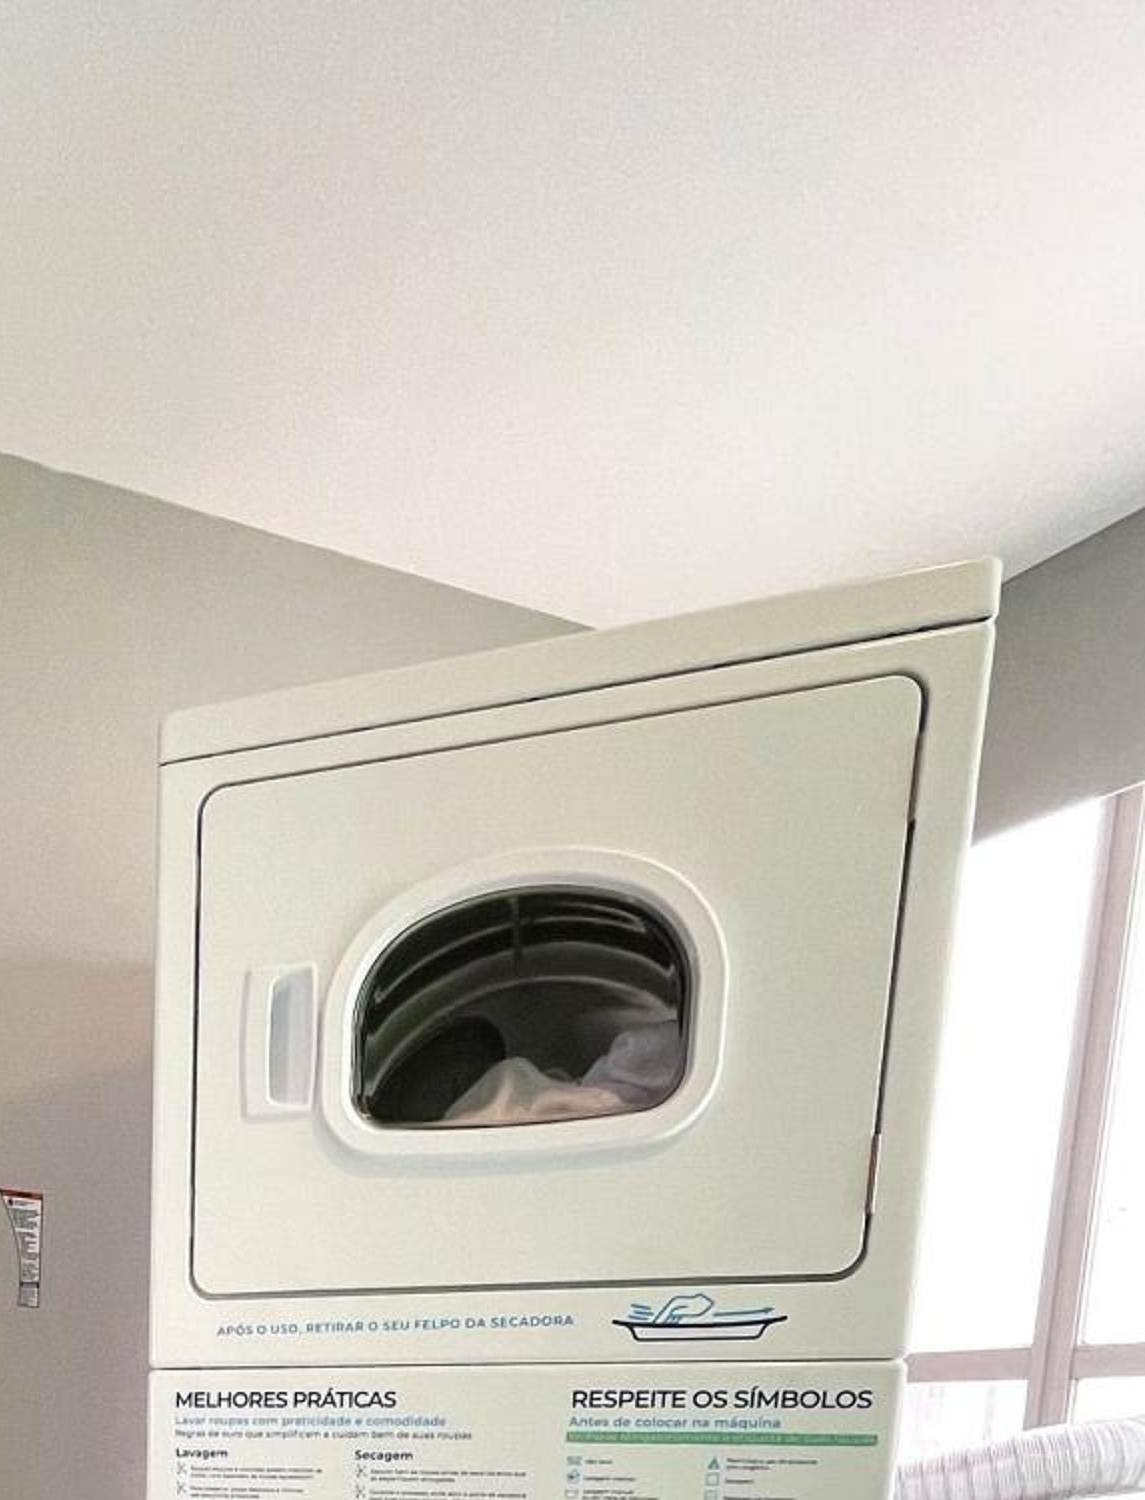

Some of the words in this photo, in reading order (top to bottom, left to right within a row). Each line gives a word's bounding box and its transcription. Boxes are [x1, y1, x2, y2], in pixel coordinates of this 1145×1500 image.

[216, 1321, 254, 1336] APÓS
[257, 1324, 267, 1335] O
[271, 1323, 301, 1336] USO,
[306, 1321, 364, 1334] RETIRAR
[368, 1321, 378, 1332] O
[382, 1319, 410, 1332] SEU
[414, 1318, 461, 1331] FELPO
[465, 1316, 486, 1329] DA
[491, 1314, 574, 1328] SECADORA
[176, 1391, 288, 1409] MELHORES
[293, 1387, 397, 1409] PRÁTICAS
[572, 1390, 687, 1409] RESPEITE
[692, 1390, 728, 1409] OS
[734, 1385, 873, 1409] SÍMBOLOS
[175, 1416, 206, 1426] Lavar
[208, 1417, 249, 1428] roupas
[252, 1417, 278, 1426] com
[282, 1416, 352, 1428] praticidade
[366, 1416, 447, 1427] comodidade
[569, 1416, 609, 1428] Antes
[613, 1416, 631, 1428] de
[635, 1416, 688, 1429] colocar
[693, 1418, 710, 1428] na
[715, 1416, 781, 1429] máquina
[176, 1448, 228, 1460] Lavagem
[355, 1450, 413, 1462] Secagem
